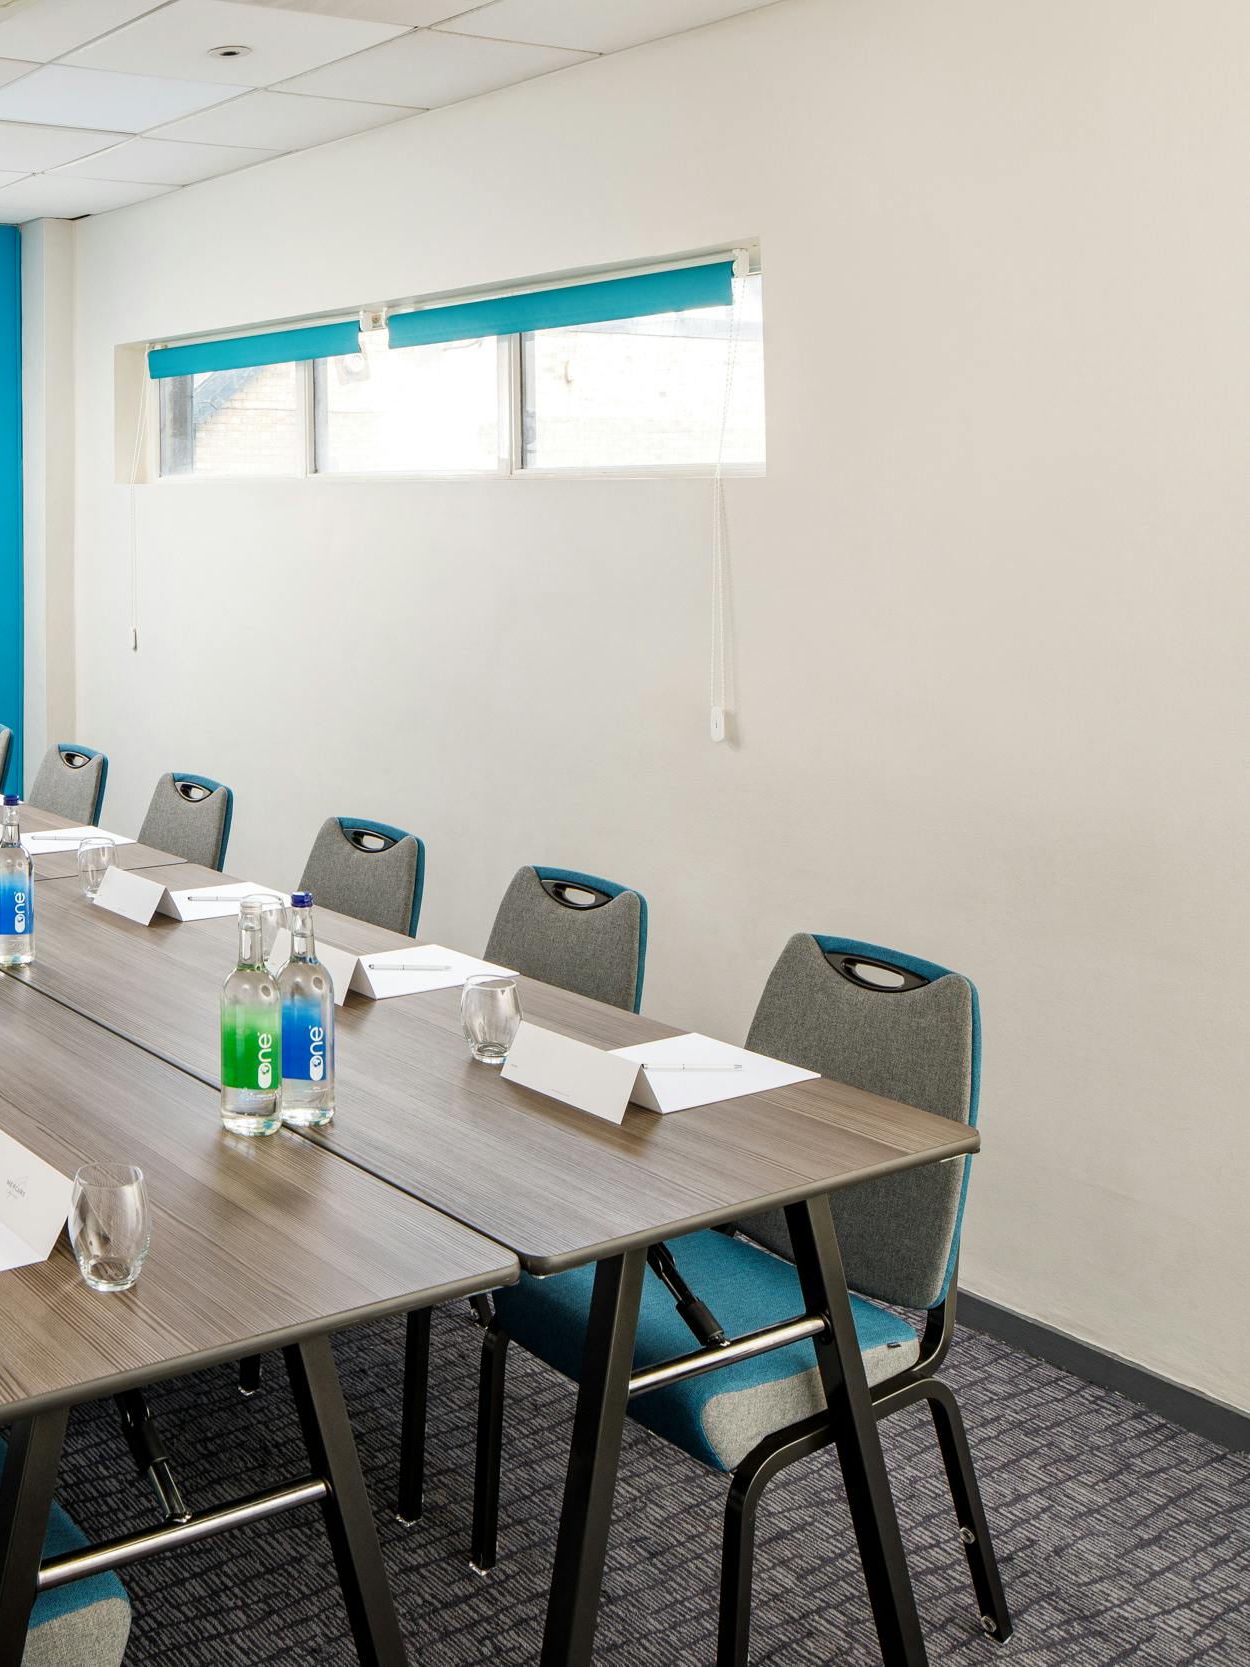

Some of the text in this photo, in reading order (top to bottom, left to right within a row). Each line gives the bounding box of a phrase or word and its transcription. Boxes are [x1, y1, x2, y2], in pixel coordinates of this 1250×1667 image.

[14, 891, 25, 934] one
[257, 1032, 272, 1089] one
[309, 1026, 324, 1081] one
